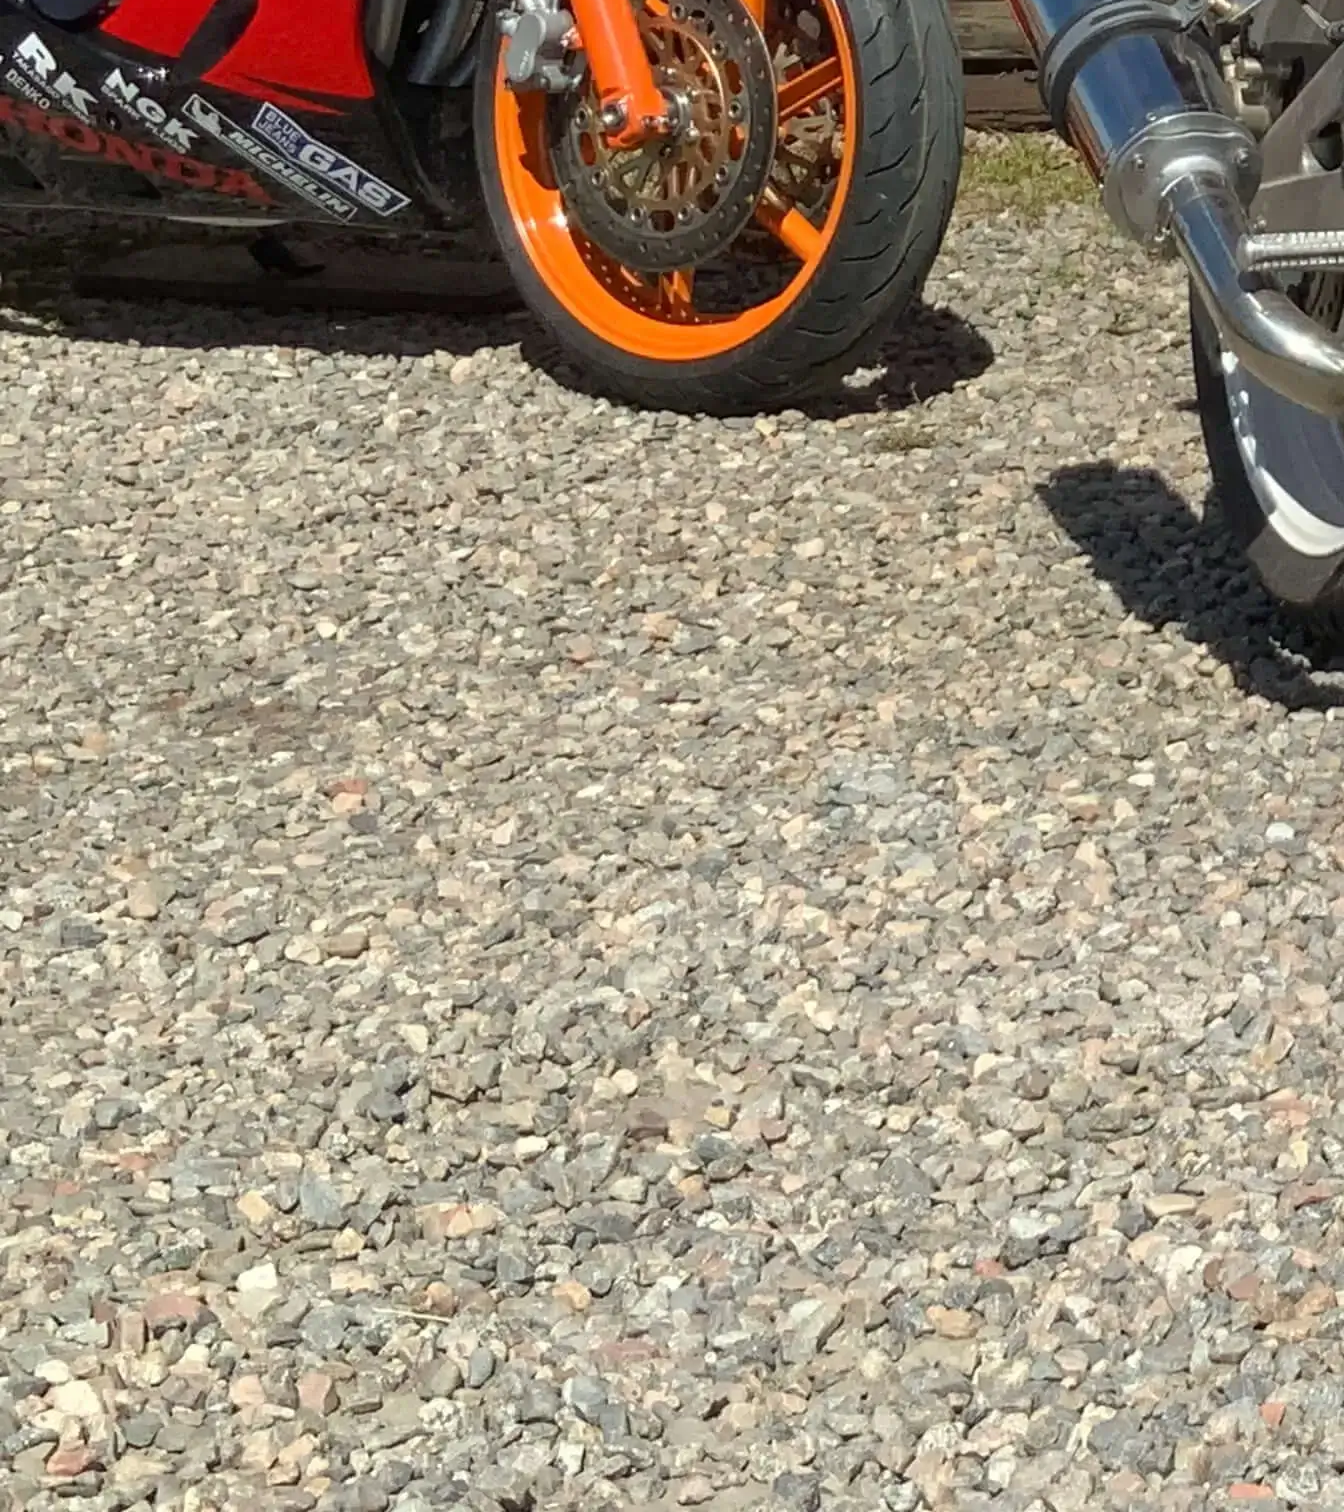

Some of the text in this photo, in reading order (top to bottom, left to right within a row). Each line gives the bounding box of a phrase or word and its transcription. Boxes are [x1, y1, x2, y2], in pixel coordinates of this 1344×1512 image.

[5, 68, 50, 110] DENKO
[17, 32, 99, 116] RK
[104, 67, 199, 150] NGK
[258, 121, 298, 155] JEANS
[264, 109, 303, 142] BLUE
[228, 131, 350, 213] MICHELIN
[298, 143, 392, 208] GAS
